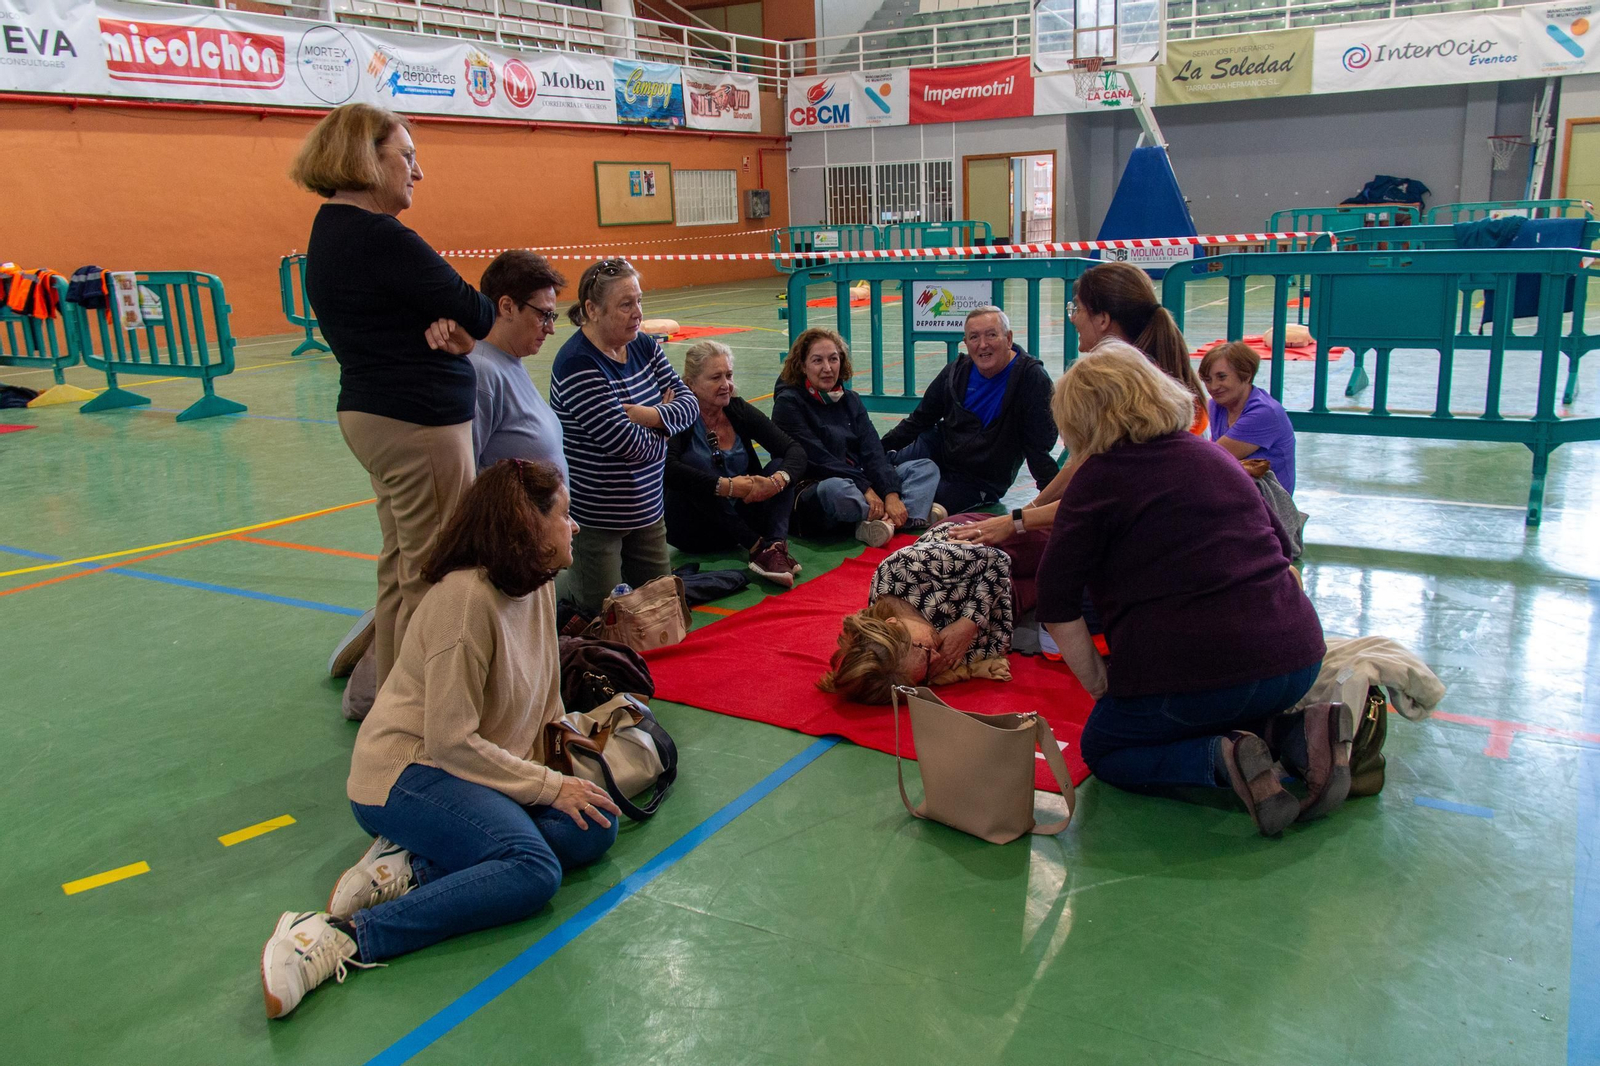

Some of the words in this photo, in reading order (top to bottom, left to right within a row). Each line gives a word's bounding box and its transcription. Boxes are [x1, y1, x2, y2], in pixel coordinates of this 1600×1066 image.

[1547, 5, 1592, 14] MANCOMUNIDAD
[1556, 10, 1592, 18] MUNICIPIOS
[3, 25, 78, 58] EVA
[101, 24, 280, 75] micolchón
[304, 45, 348, 58] MORTEX
[1192, 47, 1229, 58] SERVICIOS
[1229, 43, 1275, 54] FUNERARIOS
[1374, 39, 1498, 63] InterOcio
[0, 58, 66, 69] CONSULTORES
[1172, 60, 1203, 82] La
[1210, 52, 1296, 80] Soledad
[1469, 54, 1518, 66] Eventos
[403, 64, 456, 85] deportes
[541, 71, 605, 91] Molben
[624, 66, 673, 109] Campoy
[923, 75, 1015, 106] Impermotril
[1185, 82, 1226, 92] TARRAGONA
[1227, 79, 1267, 89] HERMANOS
[1088, 92, 1101, 101] LA
[1103, 88, 1133, 100] CAÑA
[790, 104, 850, 126] CBCM
[1130, 248, 1165, 257] MOLINA
[1166, 247, 1189, 256] OLEA
[945, 299, 988, 309] deportes
